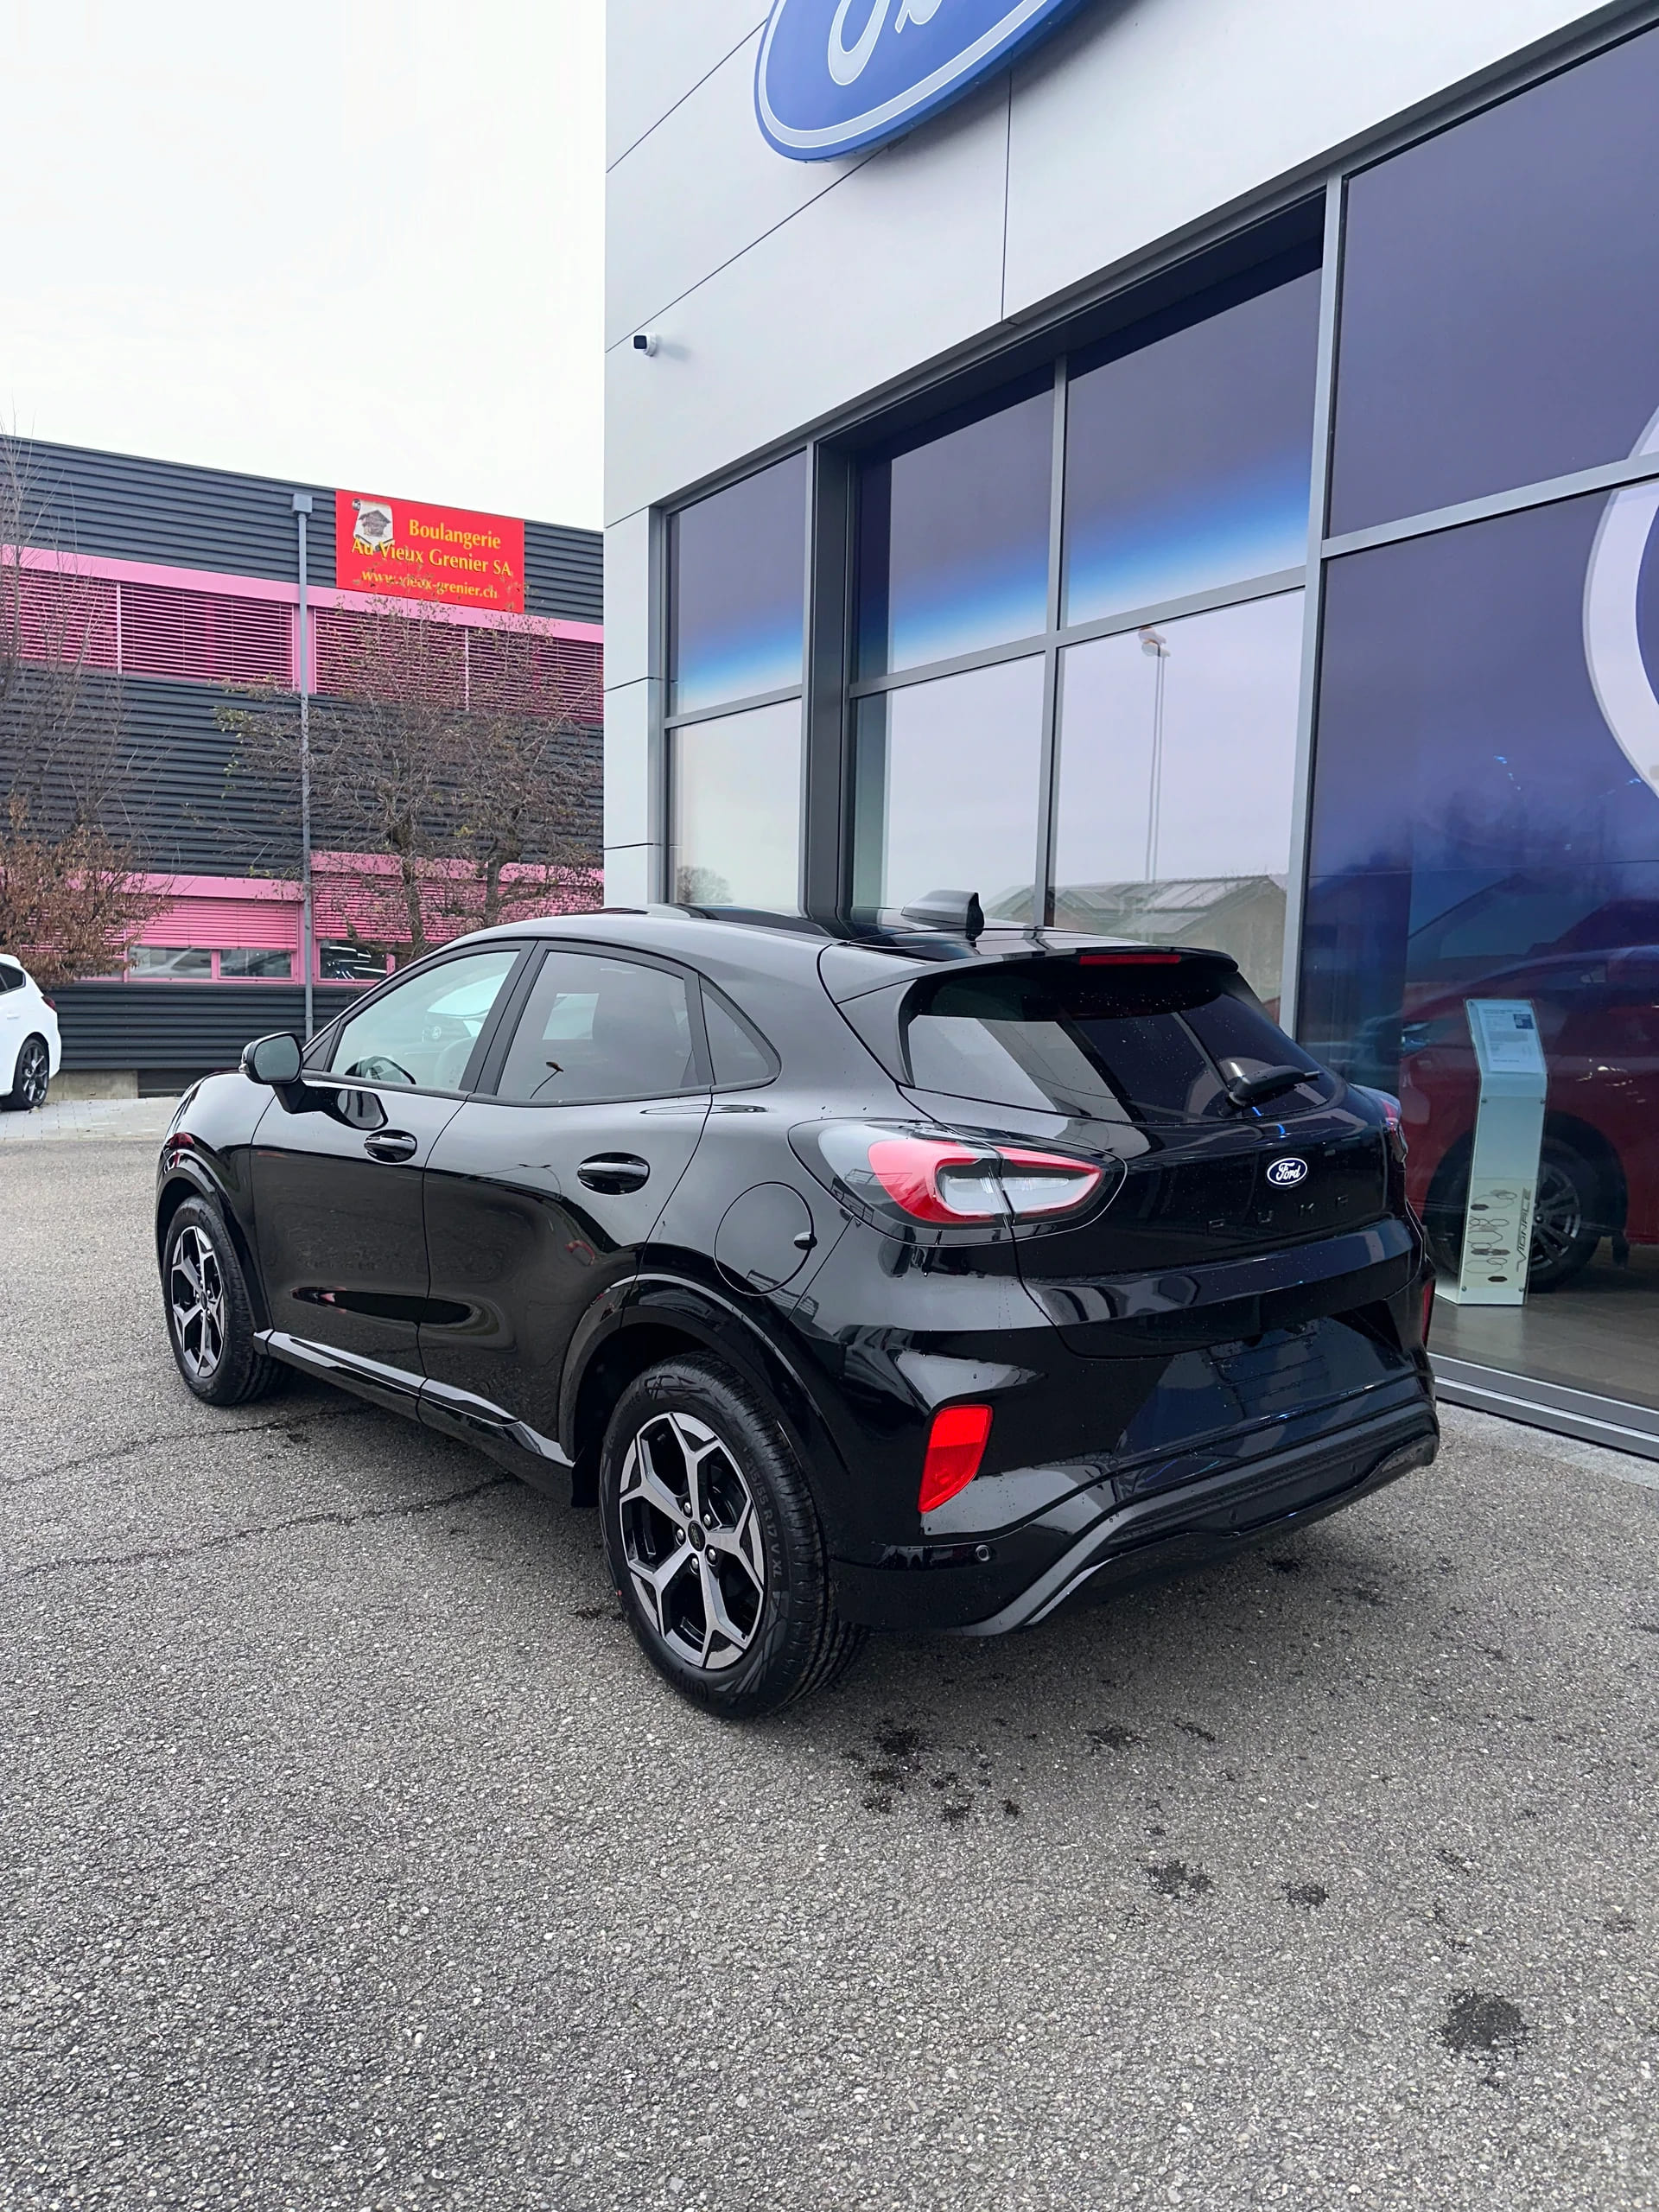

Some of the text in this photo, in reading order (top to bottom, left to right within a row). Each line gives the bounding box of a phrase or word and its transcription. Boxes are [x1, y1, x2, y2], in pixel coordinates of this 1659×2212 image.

[410, 518, 502, 550] Boulangerie
[351, 537, 512, 577] Au Vieux Grenier SA
[1275, 1161, 1301, 1181] Ford
